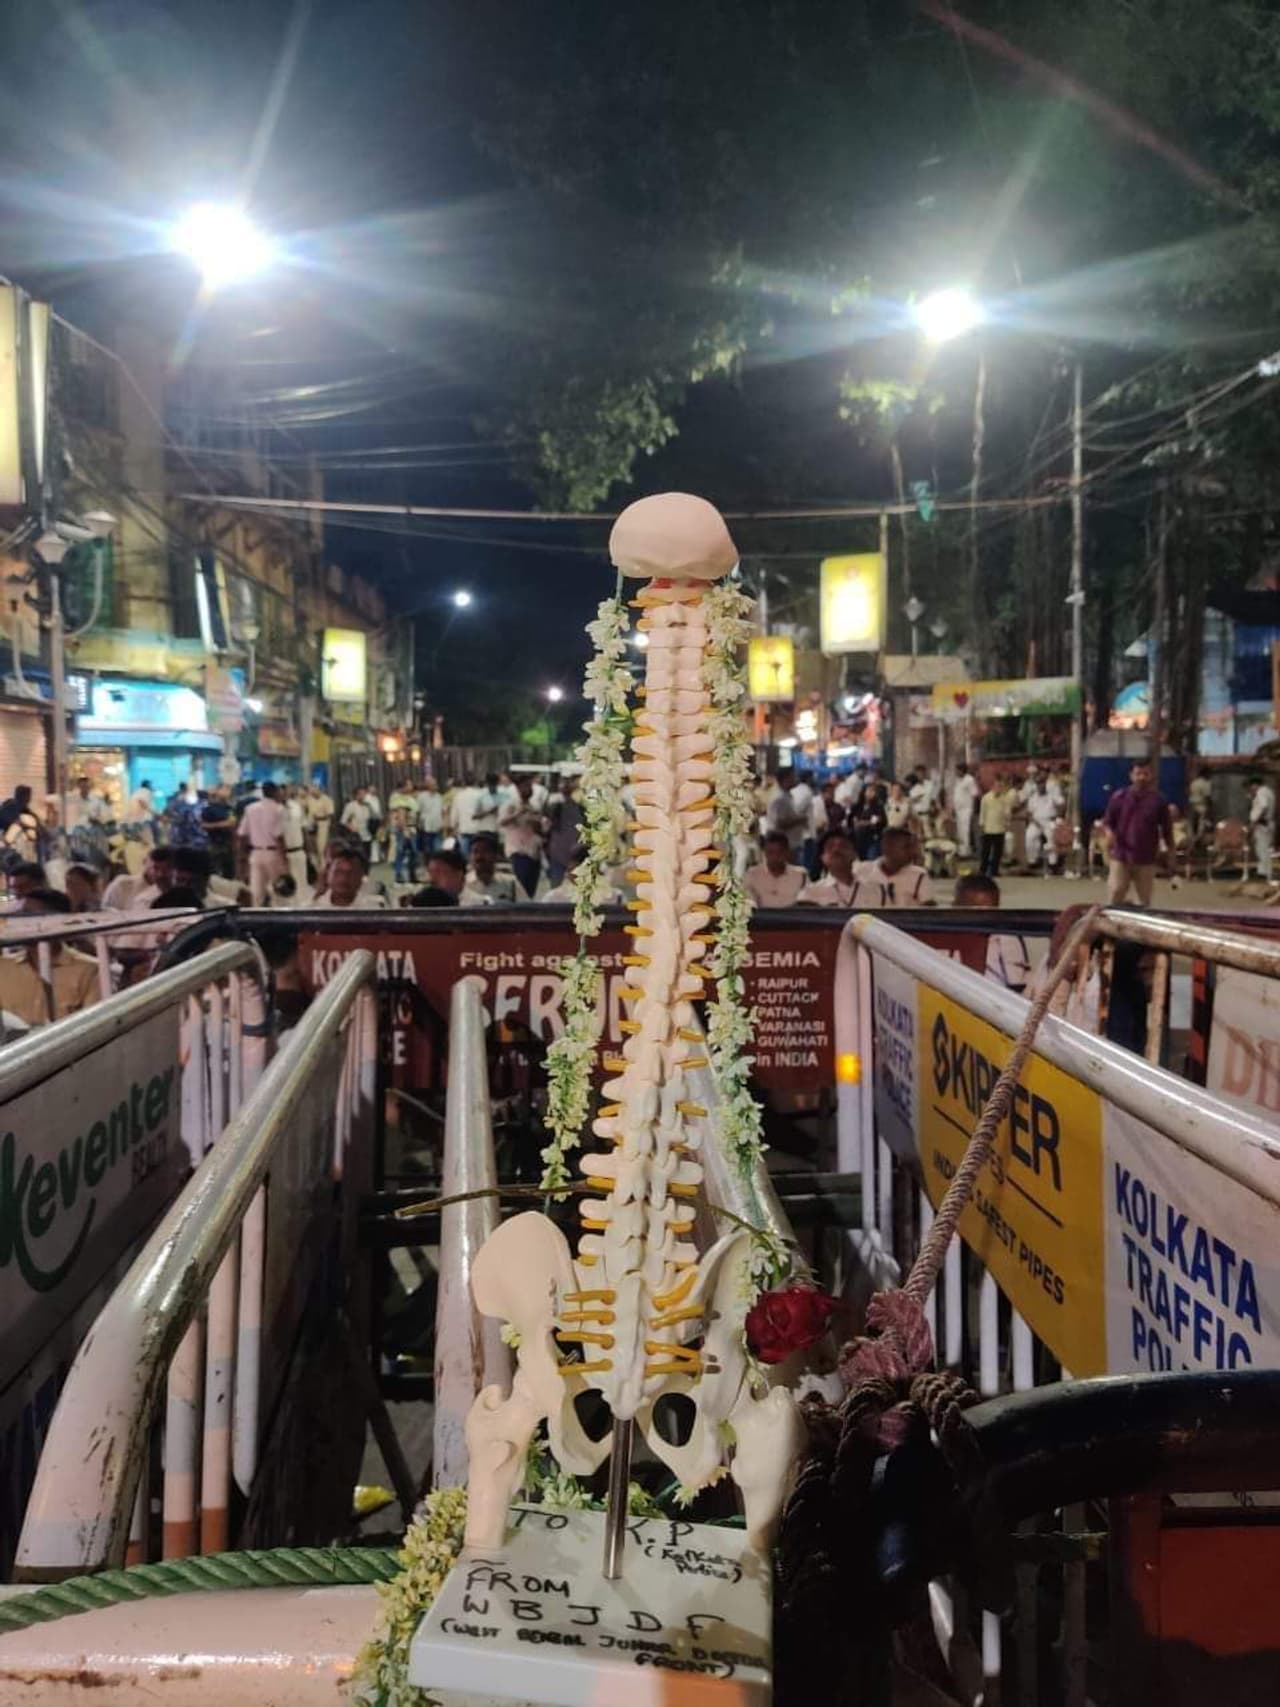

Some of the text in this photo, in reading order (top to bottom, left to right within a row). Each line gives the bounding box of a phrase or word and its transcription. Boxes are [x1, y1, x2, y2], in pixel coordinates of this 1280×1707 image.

[312, 950, 417, 985] KOATA
[460, 952, 525, 971] Fight
[531, 952, 622, 970] aganst
[757, 978, 809, 990] RAIPUR
[757, 991, 819, 1004] CUTTACK
[757, 1007, 801, 1018] PATNA
[758, 1021, 826, 1032] VARANASI
[757, 1035, 828, 1047] GUWAHATI
[757, 1051, 819, 1067] in INDIA
[933, 1012, 1062, 1193] SKIPER
[0, 1066, 174, 1292] Keventer
[1115, 1162, 1262, 1335] KOLKATA
[1019, 1241, 1065, 1304] PIPES
[1122, 1232, 1252, 1369] TRAFFIC
[510, 1507, 568, 1530] TO
[466, 1567, 571, 1598] FROM
